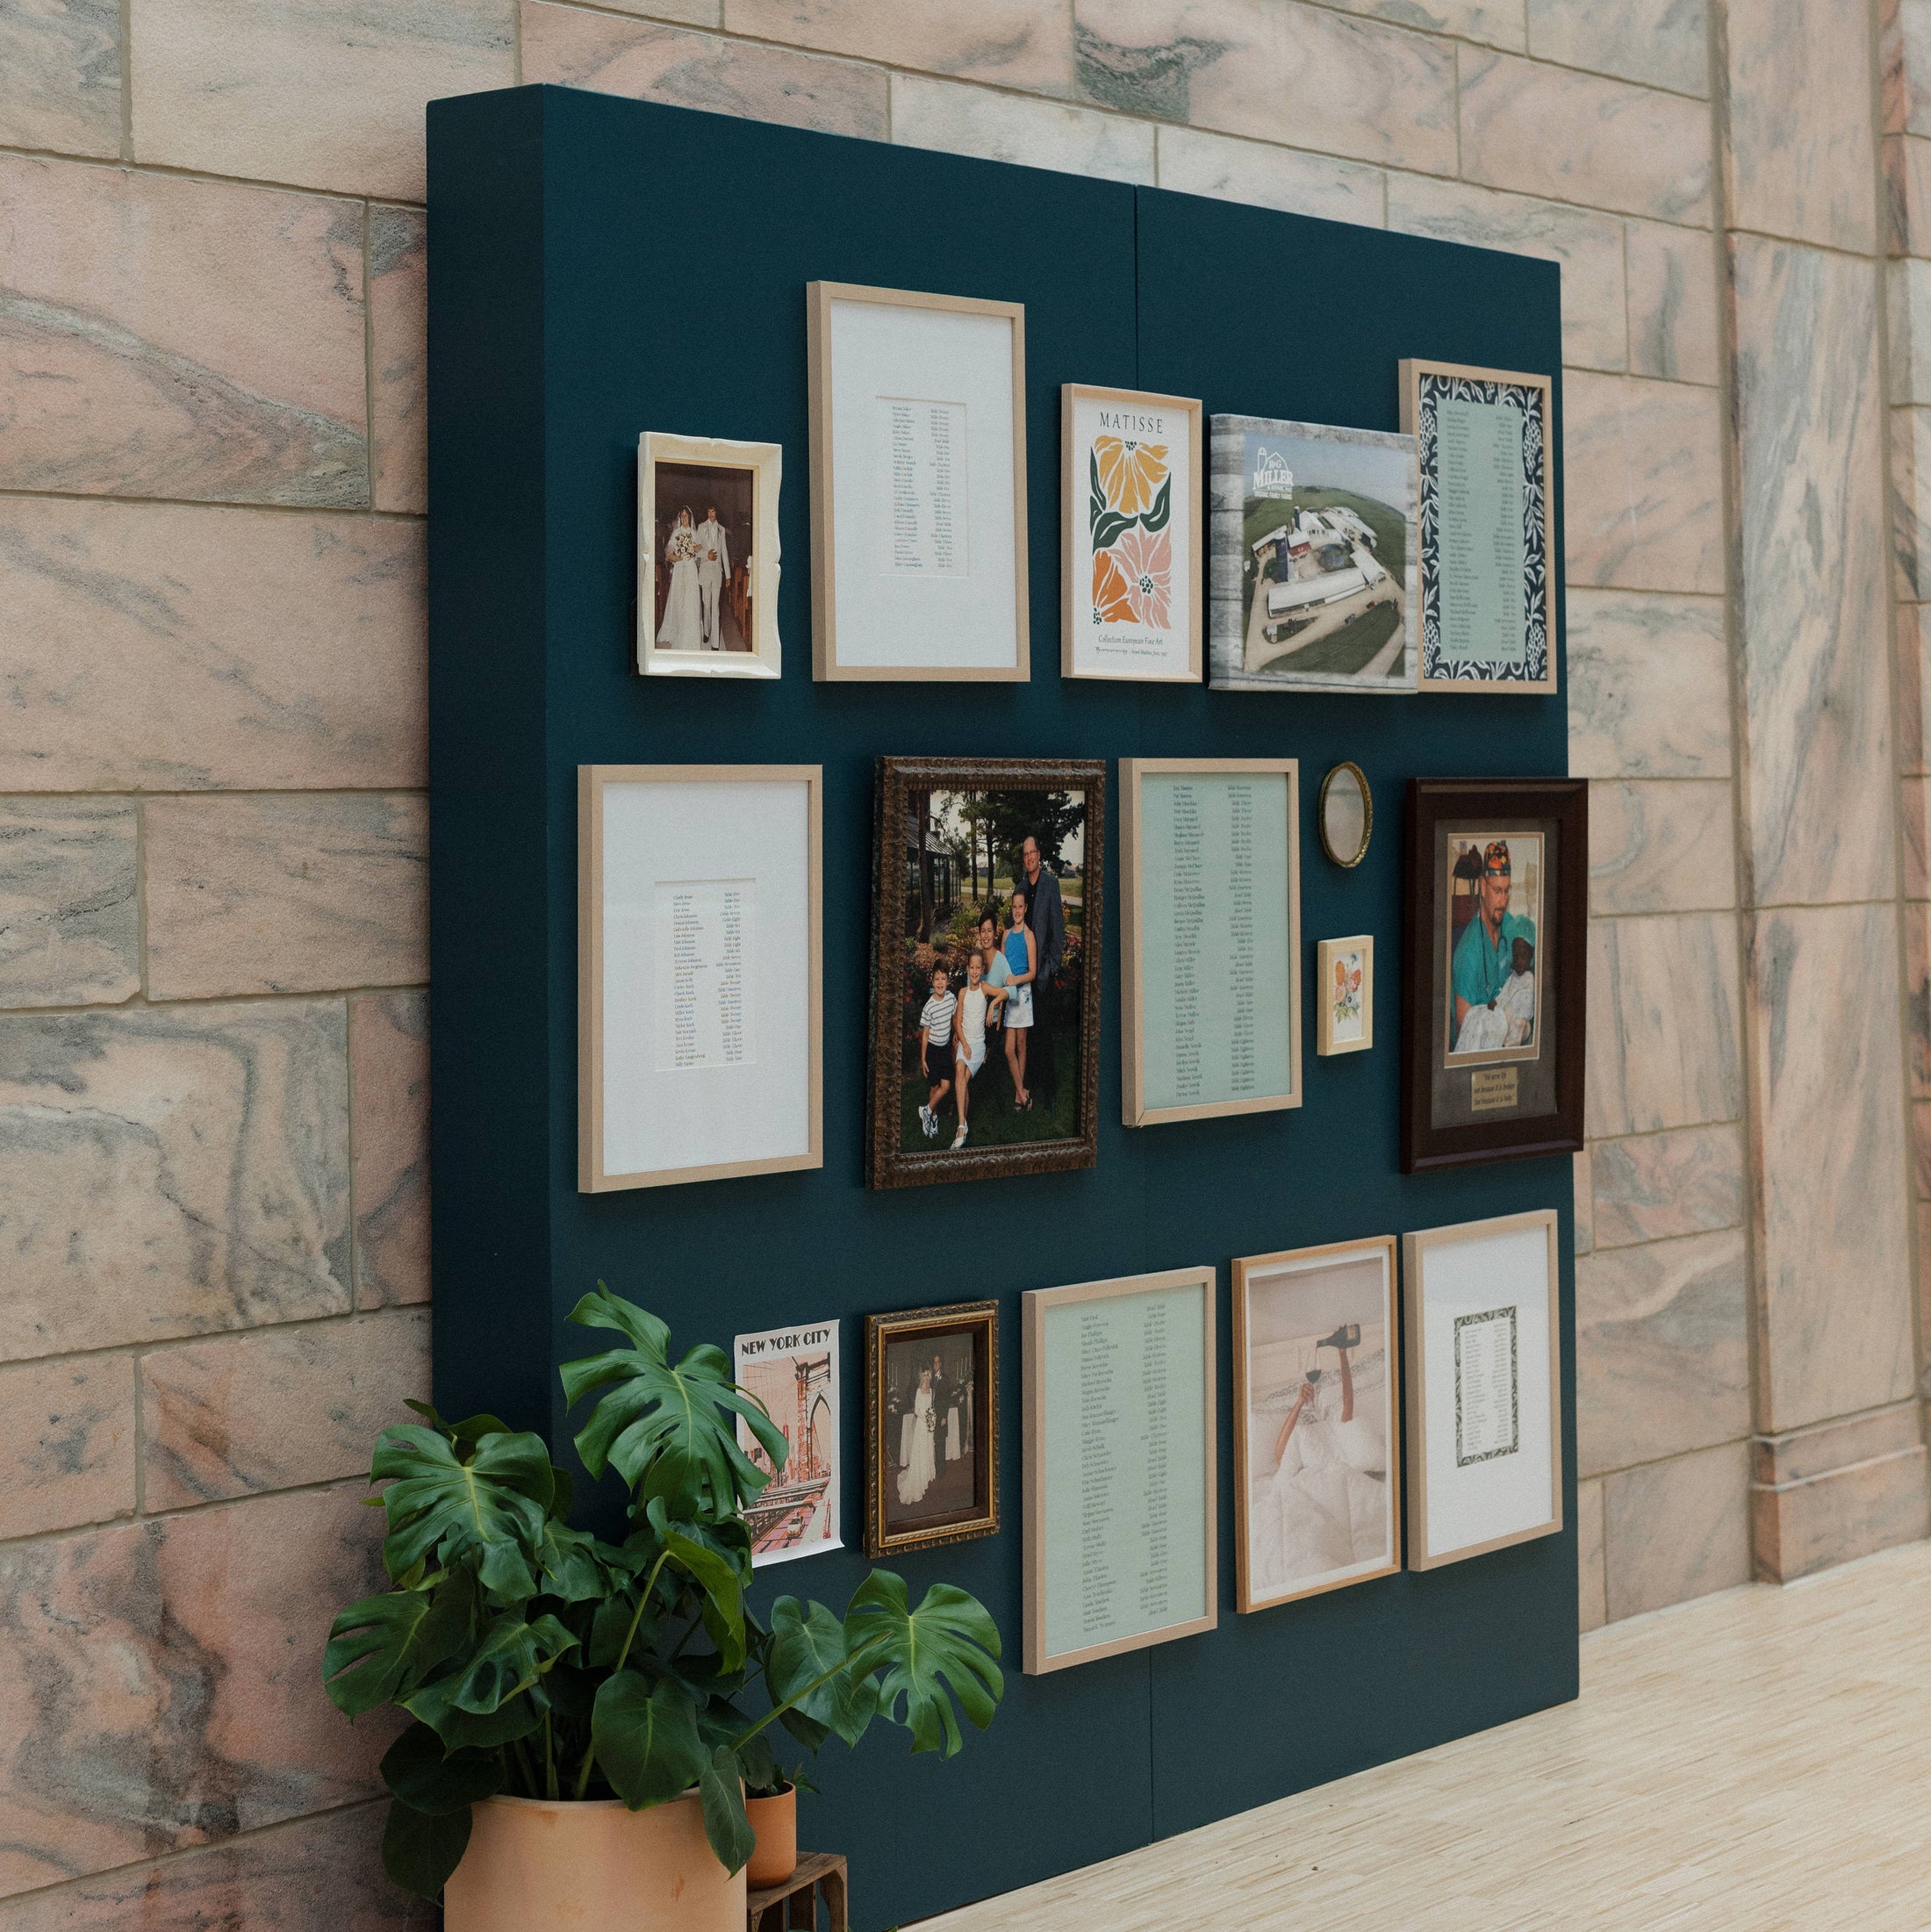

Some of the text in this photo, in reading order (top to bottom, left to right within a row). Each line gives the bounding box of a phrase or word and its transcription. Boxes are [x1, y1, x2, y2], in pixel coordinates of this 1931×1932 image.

[1100, 412, 1163, 434] MATISSE
[1253, 469, 1294, 490] MILLER
[1098, 634, 1122, 643] Collection
[1122, 636, 1144, 646] European
[742, 1329, 830, 1356] NEW YORK CITY
